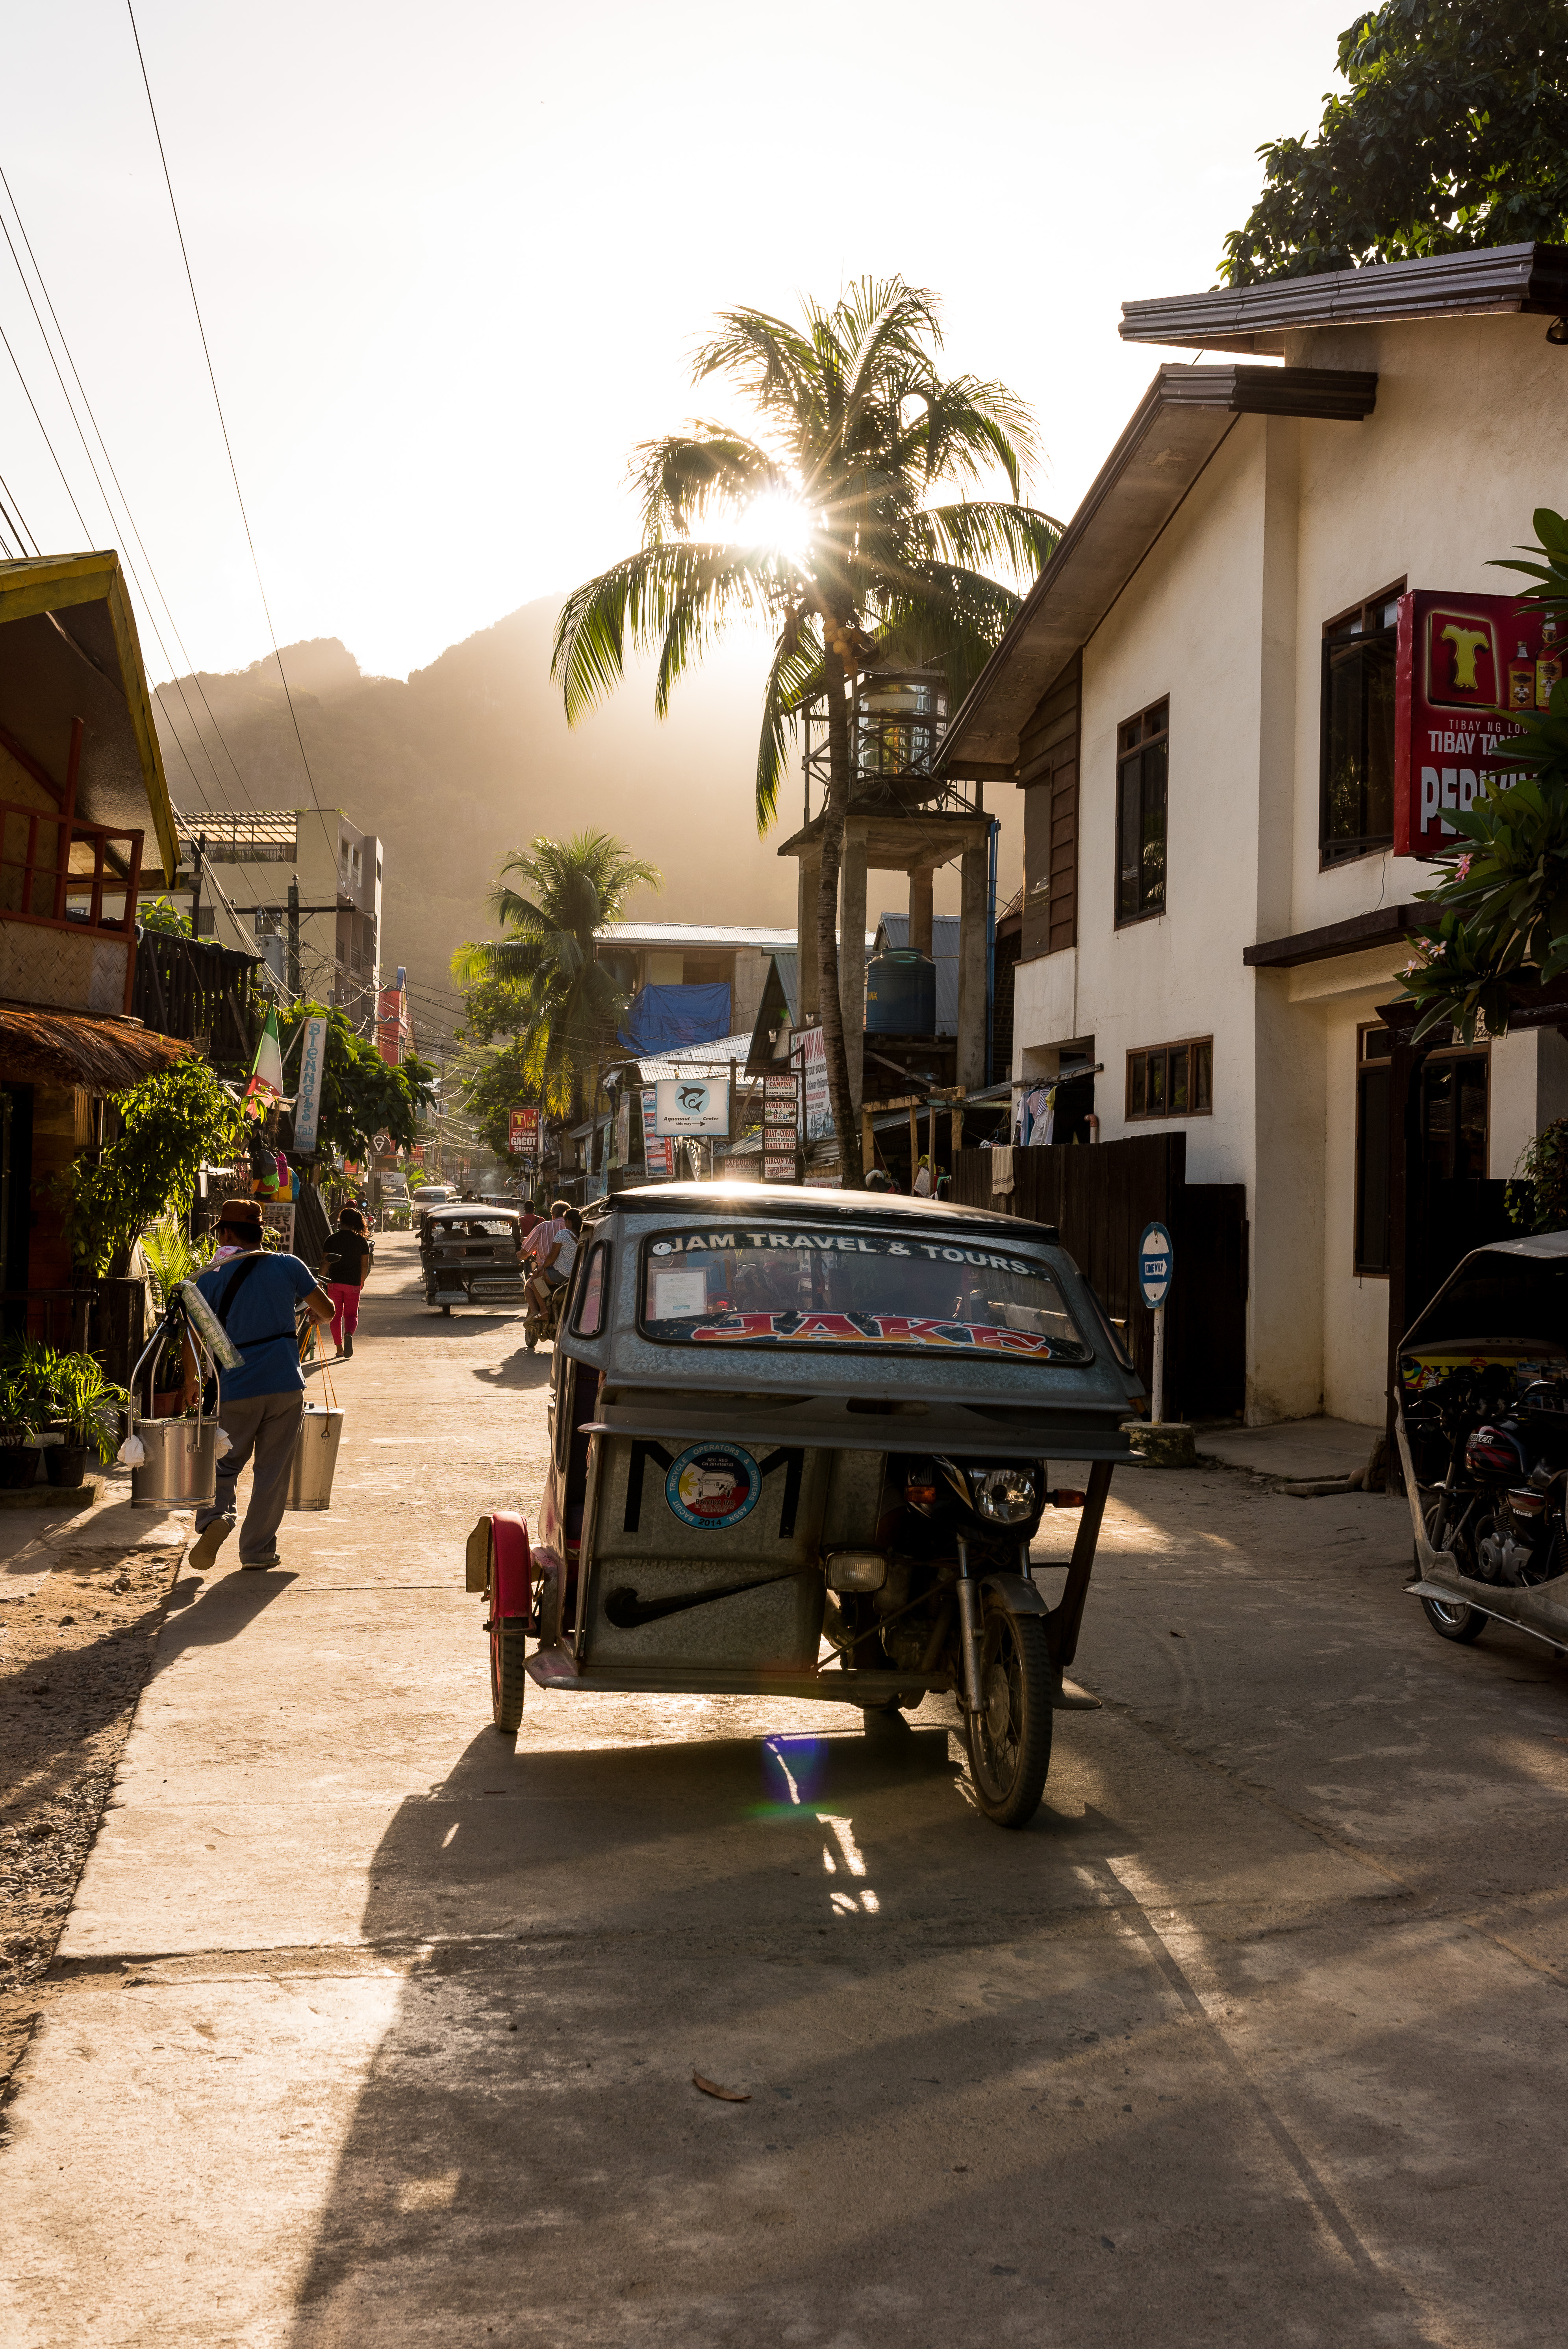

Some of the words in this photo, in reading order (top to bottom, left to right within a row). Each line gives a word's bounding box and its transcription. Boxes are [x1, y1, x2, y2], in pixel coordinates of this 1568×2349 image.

[1449, 719, 1481, 731] TIBAY
[1488, 722, 1501, 733] NG
[1508, 723, 1528, 734] LOO
[1428, 730, 1476, 754] TIBAY
[297, 1125, 313, 1135] Fab
[765, 1129, 777, 1138] BOAT
[780, 1129, 795, 1138] CORON
[294, 1136, 315, 1149] Shoppe
[511, 1137, 537, 1146] GACOT
[671, 1233, 735, 1252] JAM
[746, 1233, 877, 1253] TRAVEL
[888, 1242, 911, 1256] &
[921, 1245, 1029, 1275] TOURS
[693, 1312, 1051, 1359] JAKE
[1468, 1433, 1494, 1444] BOXER
[693, 1444, 740, 1456] OPERATORS
[670, 1457, 688, 1491] TRICYCLE
[749, 1470, 758, 1501] DRIVERS
[672, 1501, 695, 1522] BACUIT
[727, 1506, 747, 1522] ASSN.
[698, 1518, 722, 1526] 2014
